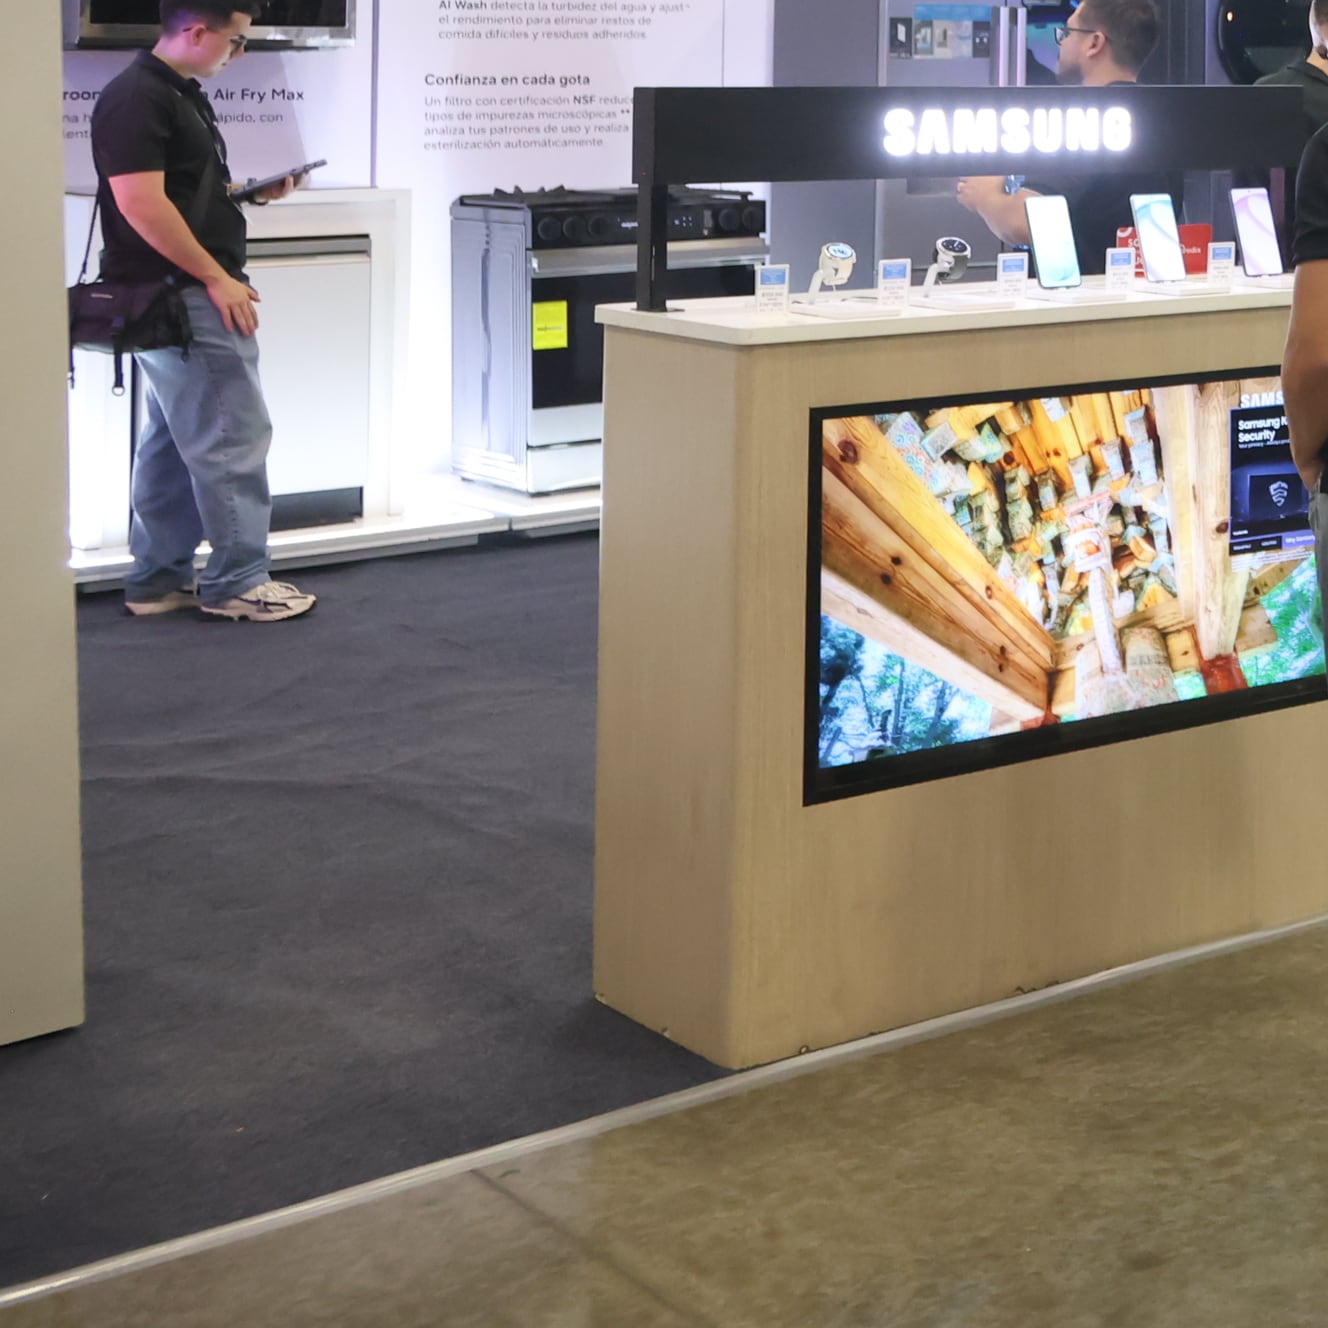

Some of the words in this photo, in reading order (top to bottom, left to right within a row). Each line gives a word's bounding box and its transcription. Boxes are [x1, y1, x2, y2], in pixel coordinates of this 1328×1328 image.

[438, 0, 451, 11] AI
[454, 0, 487, 11] Wash
[490, 0, 535, 11] detecta
[538, 1, 548, 11] la
[551, 1, 597, 12] turbidez
[600, 2, 617, 13] del
[620, 3, 647, 15] agua
[438, 15, 449, 25] el
[452, 14, 523, 26] rendimiento
[526, 16, 551, 28] para
[554, 14, 598, 25] eliminar
[601, 15, 635, 25] restos
[638, 15, 652, 25] de
[438, 29, 482, 40] comida
[542, 29, 589, 40] residuos
[424, 73, 497, 86] Confianza
[500, 75, 518, 86] en
[521, 74, 556, 86] cada
[559, 74, 591, 88] gota
[213, 88, 236, 101] Air
[240, 88, 266, 104] Fry
[271, 88, 304, 101] Max
[424, 96, 441, 106] Un
[444, 95, 472, 107] filtro
[475, 97, 497, 107] con
[500, 95, 570, 107] certificación
[573, 94, 596, 106] NSF
[259, 115, 283, 123] con
[424, 109, 454, 122] tipos
[457, 109, 472, 120] de
[475, 110, 535, 123] impurezas
[538, 108, 617, 122] microscópicas
[424, 124, 465, 136] analiza
[468, 125, 487, 135] tus
[490, 125, 540, 137] patrones
[544, 124, 559, 135] de
[561, 125, 581, 135] uso
[594, 123, 629, 134] realiza
[884, 107, 1133, 157] SAMSUNG
[424, 137, 501, 150] esterilización
[504, 136, 603, 149] automáticamente
[1240, 390, 1284, 408] SAMS
[1238, 418, 1281, 430] Samsung
[1238, 429, 1276, 443] Security
